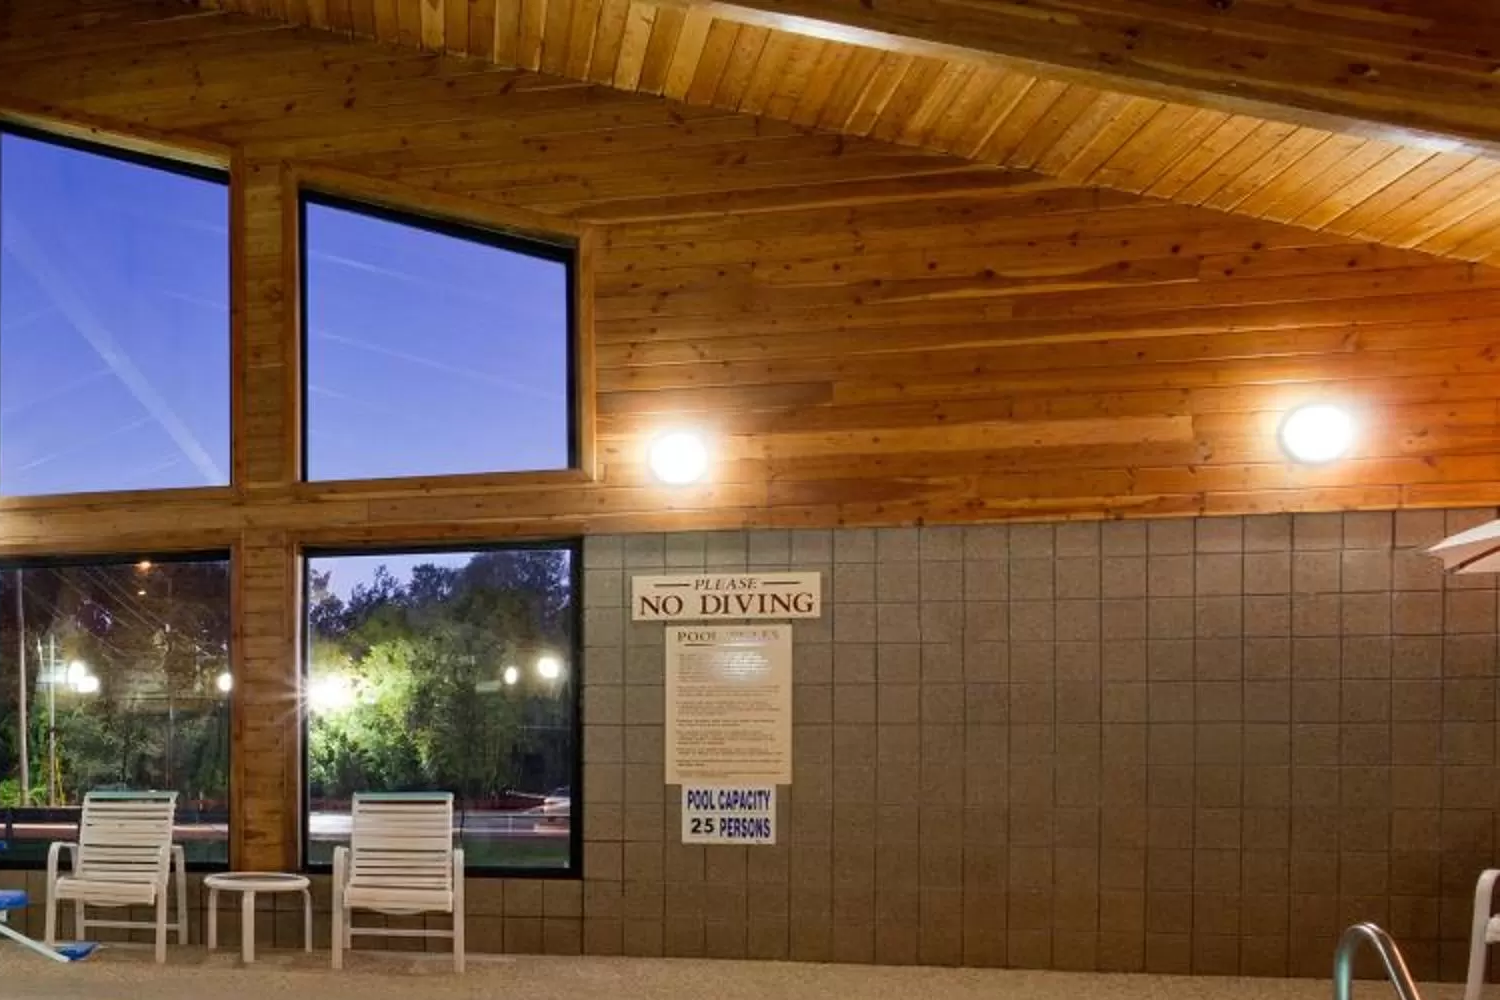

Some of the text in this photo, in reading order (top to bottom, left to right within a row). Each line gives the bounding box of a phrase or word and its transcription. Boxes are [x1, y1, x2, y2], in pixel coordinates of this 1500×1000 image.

[694, 578, 758, 591] PLEASE
[640, 592, 815, 616] NO DIVING
[687, 790, 771, 812] POOL CAPACITY
[690, 817, 771, 839] 25 PERSONS
